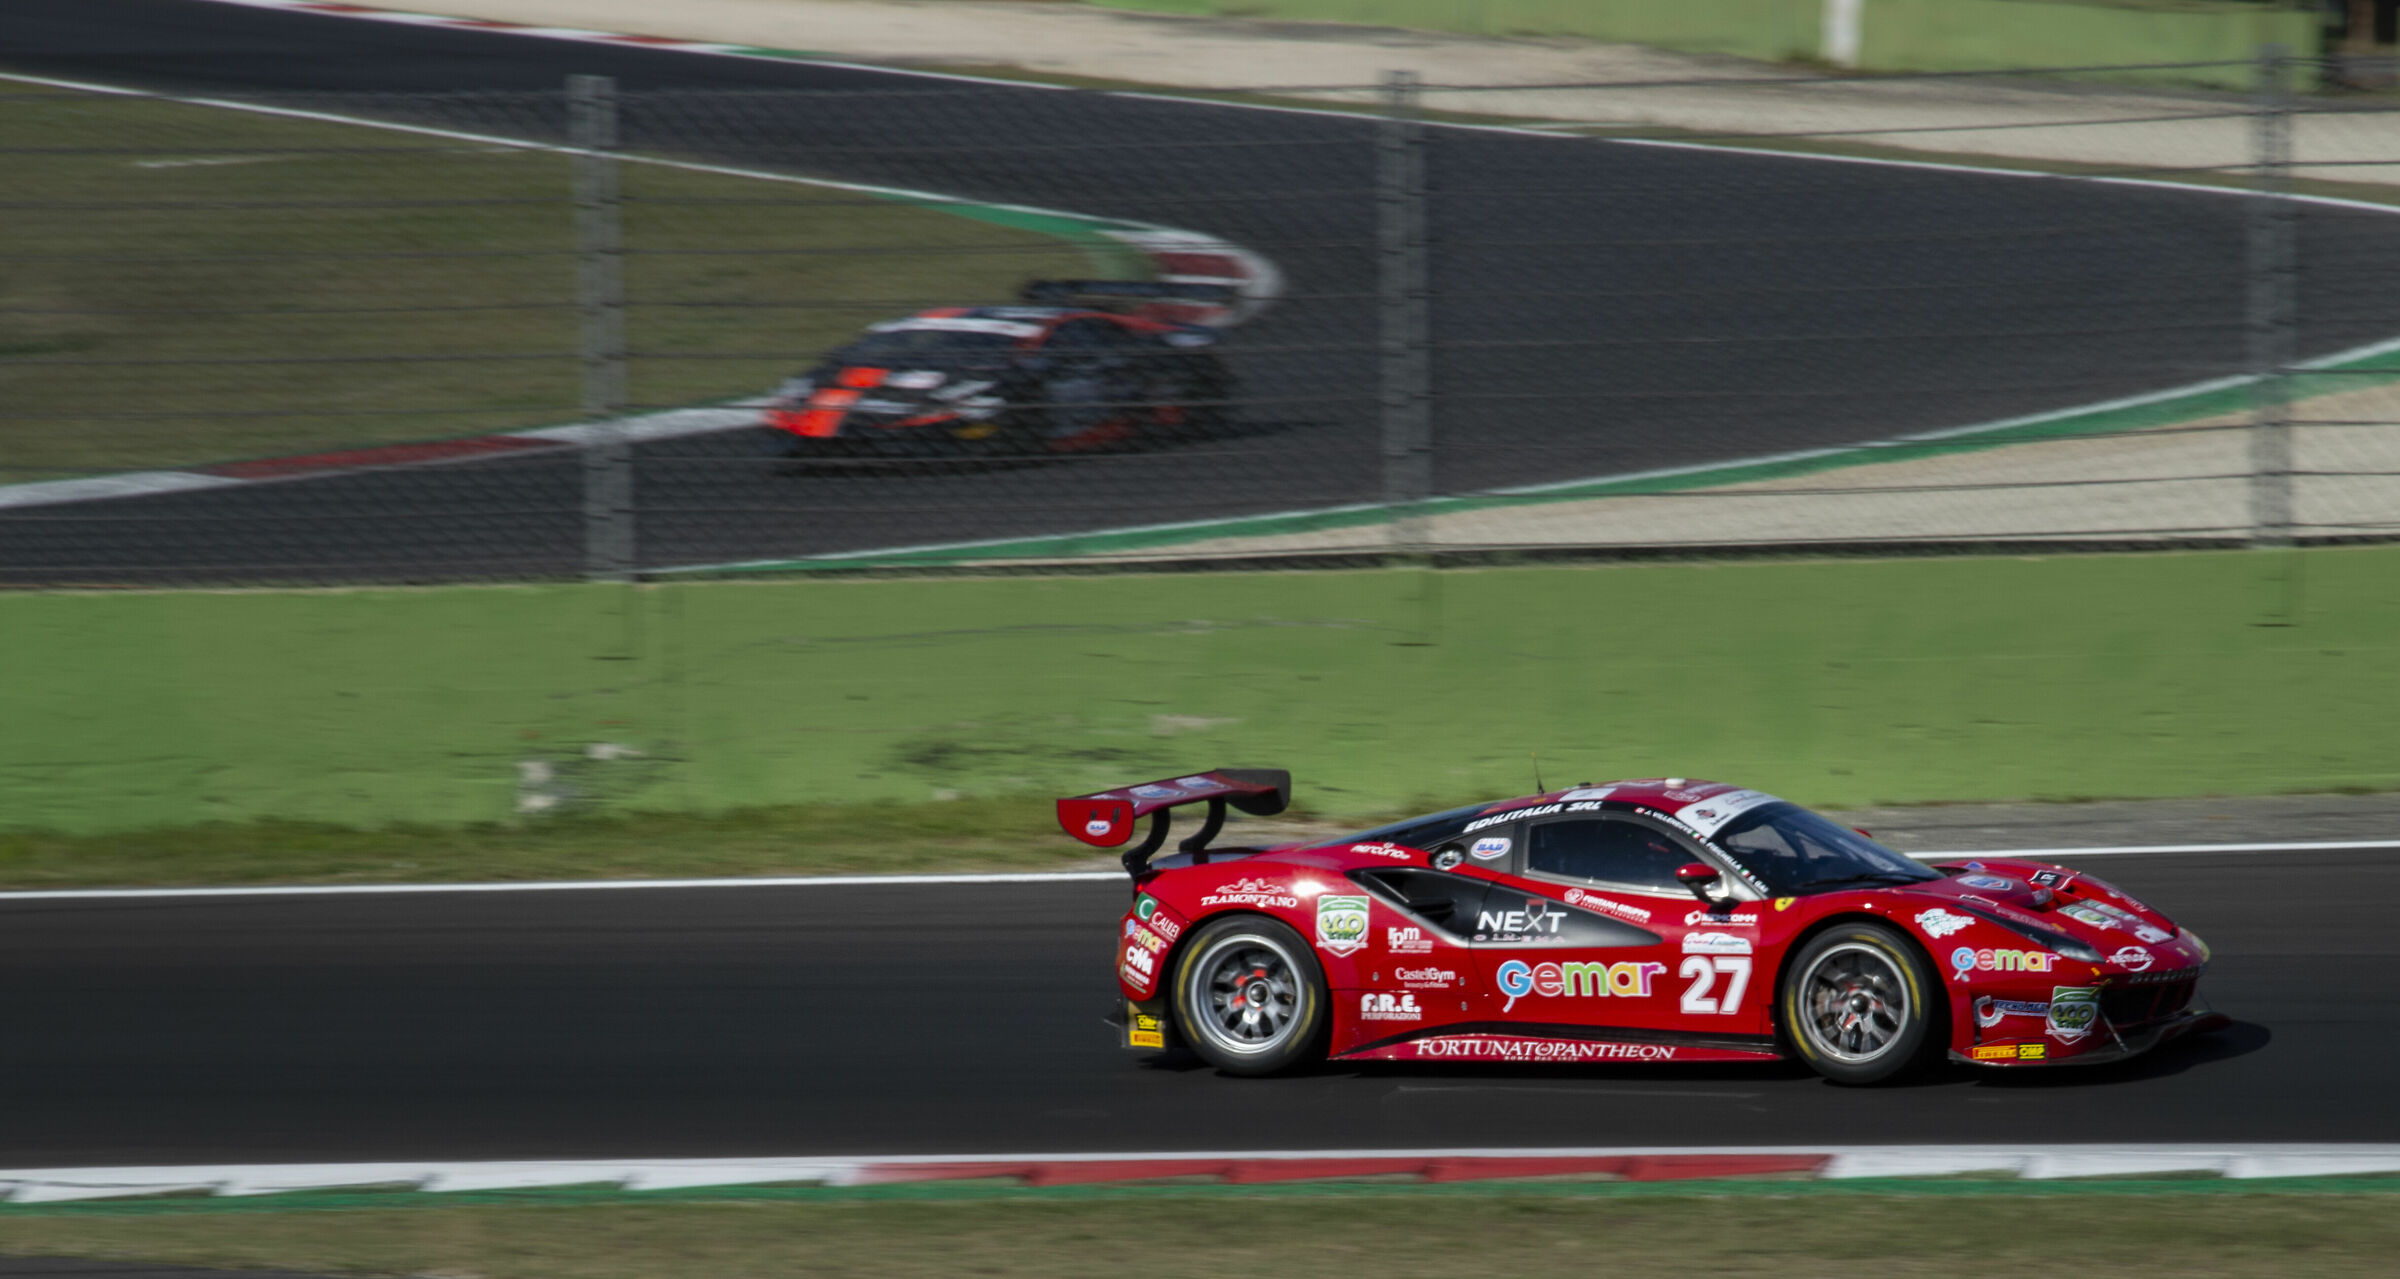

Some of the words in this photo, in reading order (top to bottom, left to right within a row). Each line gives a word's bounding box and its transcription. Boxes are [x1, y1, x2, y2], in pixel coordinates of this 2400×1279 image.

[1462, 803, 1563, 834] EDILITALIA
[1201, 893, 1298, 908] TRAMONTANO
[1477, 905, 1567, 932] NEXT
[1395, 967, 1456, 982] CastelGym
[1952, 947, 2062, 982] Gemar
[1497, 960, 1667, 1013] Gemar
[1679, 955, 1753, 1015] 27
[1361, 993, 1422, 1012] F.R.E.
